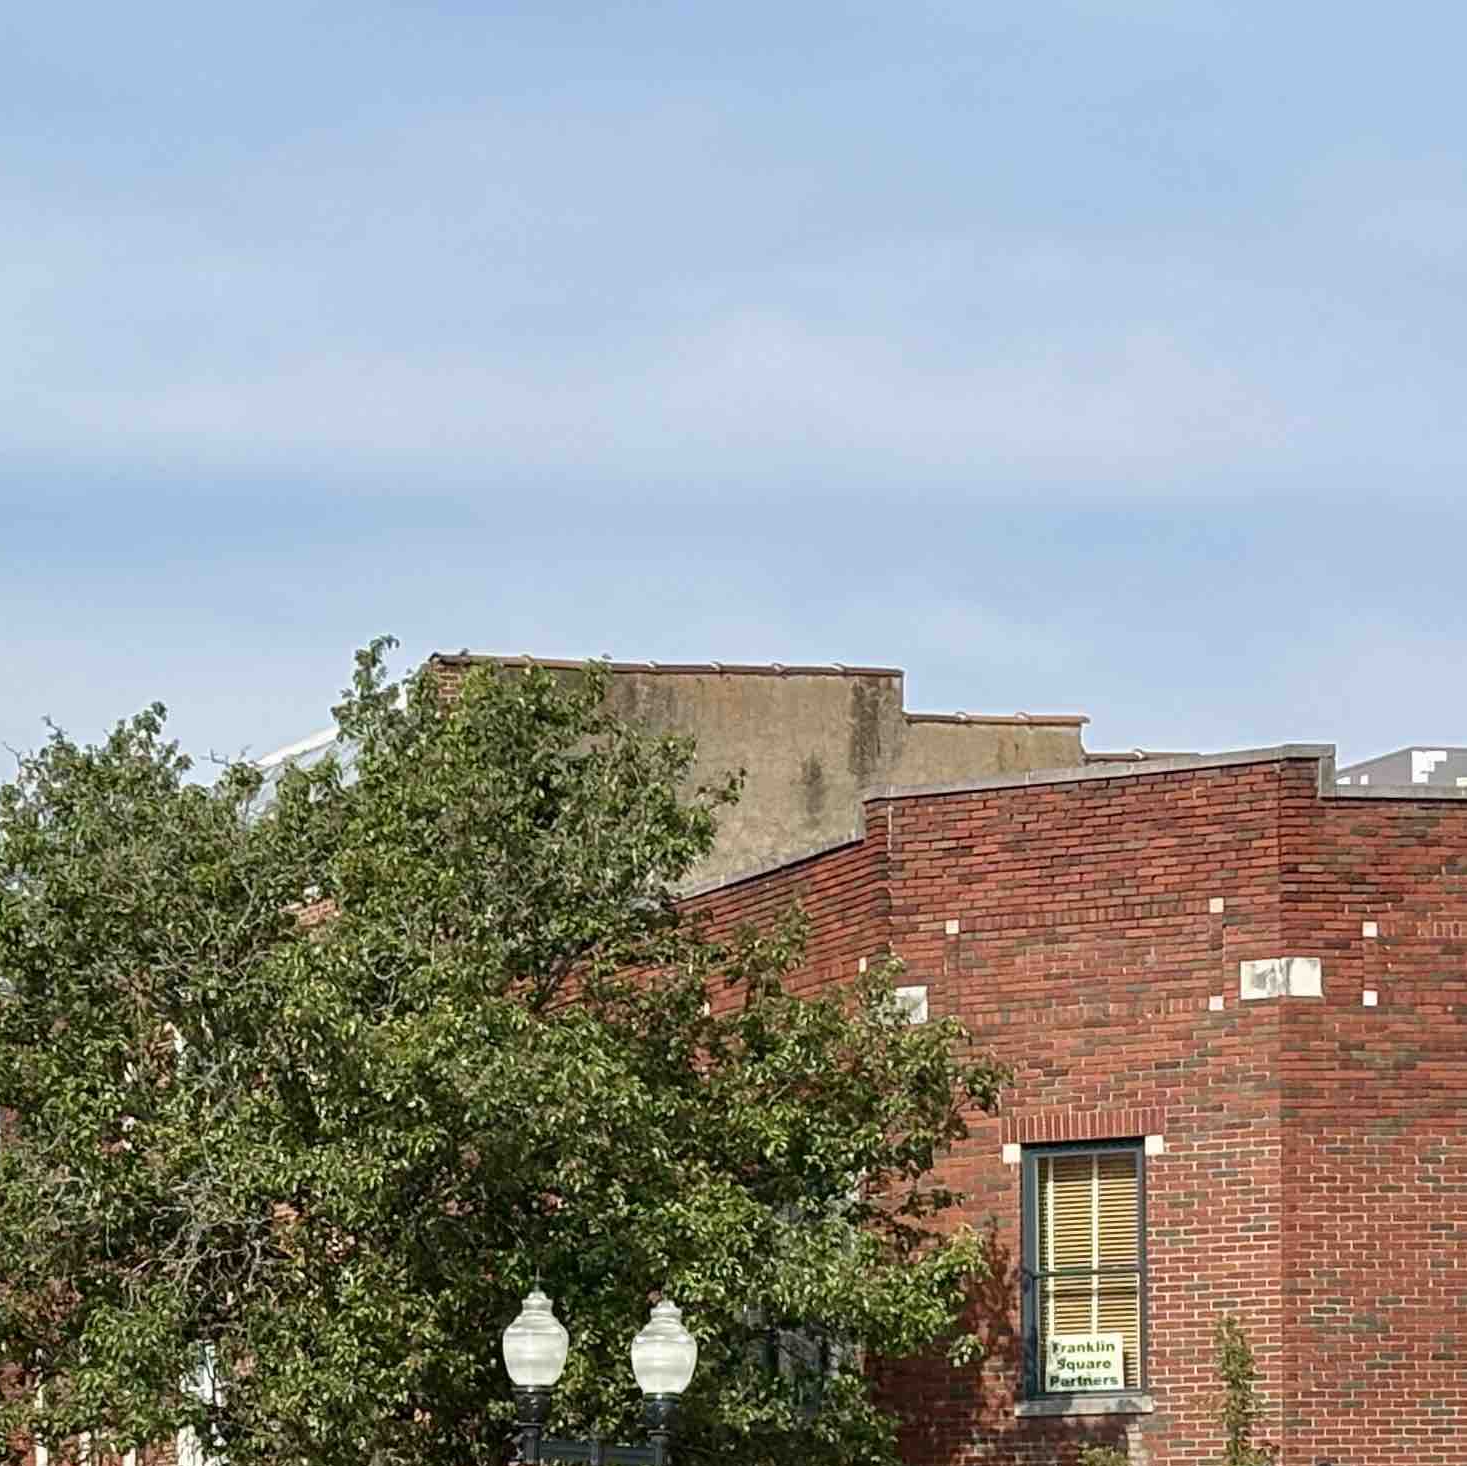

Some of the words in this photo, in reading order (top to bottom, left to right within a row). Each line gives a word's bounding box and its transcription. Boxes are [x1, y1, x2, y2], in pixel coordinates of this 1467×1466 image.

[1052, 1341, 1116, 1353] Franklin
[1057, 1358, 1111, 1373] Square
[1050, 1375, 1119, 1387] Partners
